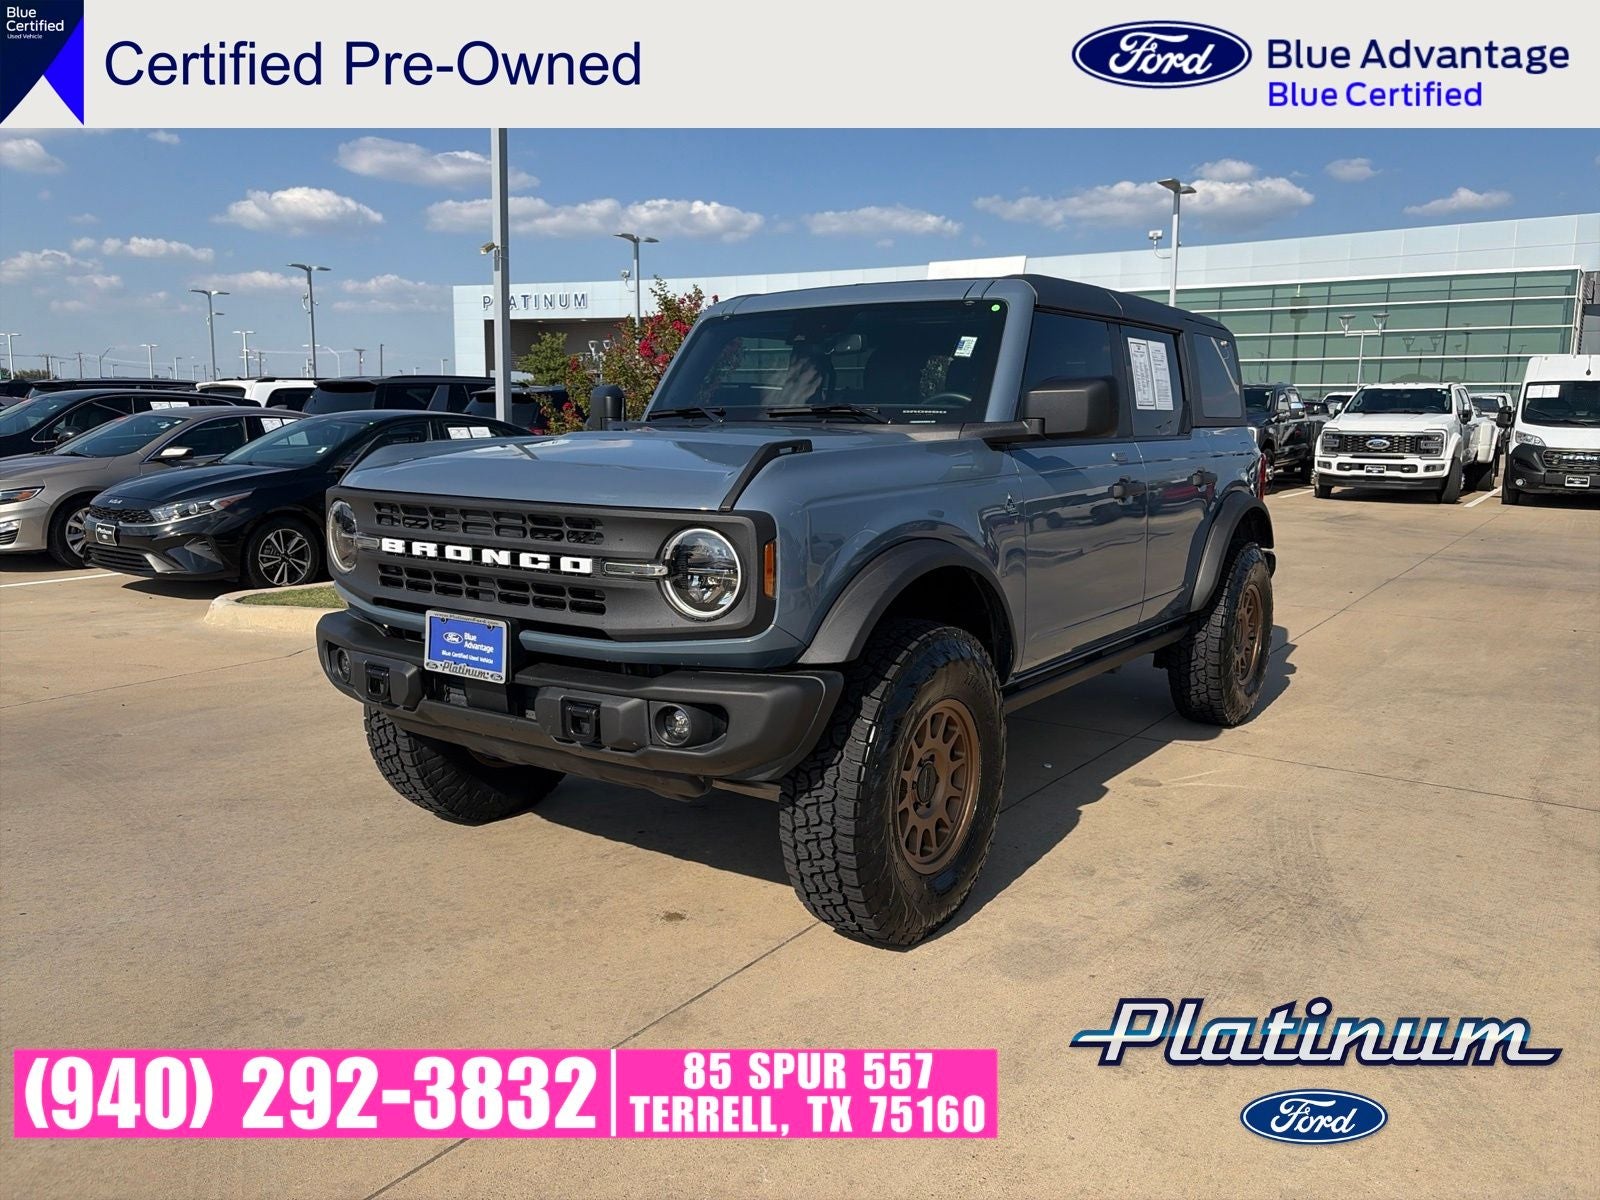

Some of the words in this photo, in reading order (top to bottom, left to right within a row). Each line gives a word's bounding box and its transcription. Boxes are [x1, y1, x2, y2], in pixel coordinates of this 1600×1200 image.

[482, 292, 588, 311] PATINUM
[381, 537, 594, 574] BRONCO
[464, 632, 477, 642] Blue
[464, 641, 495, 653] Advantage
[442, 661, 490, 680] Platinum
